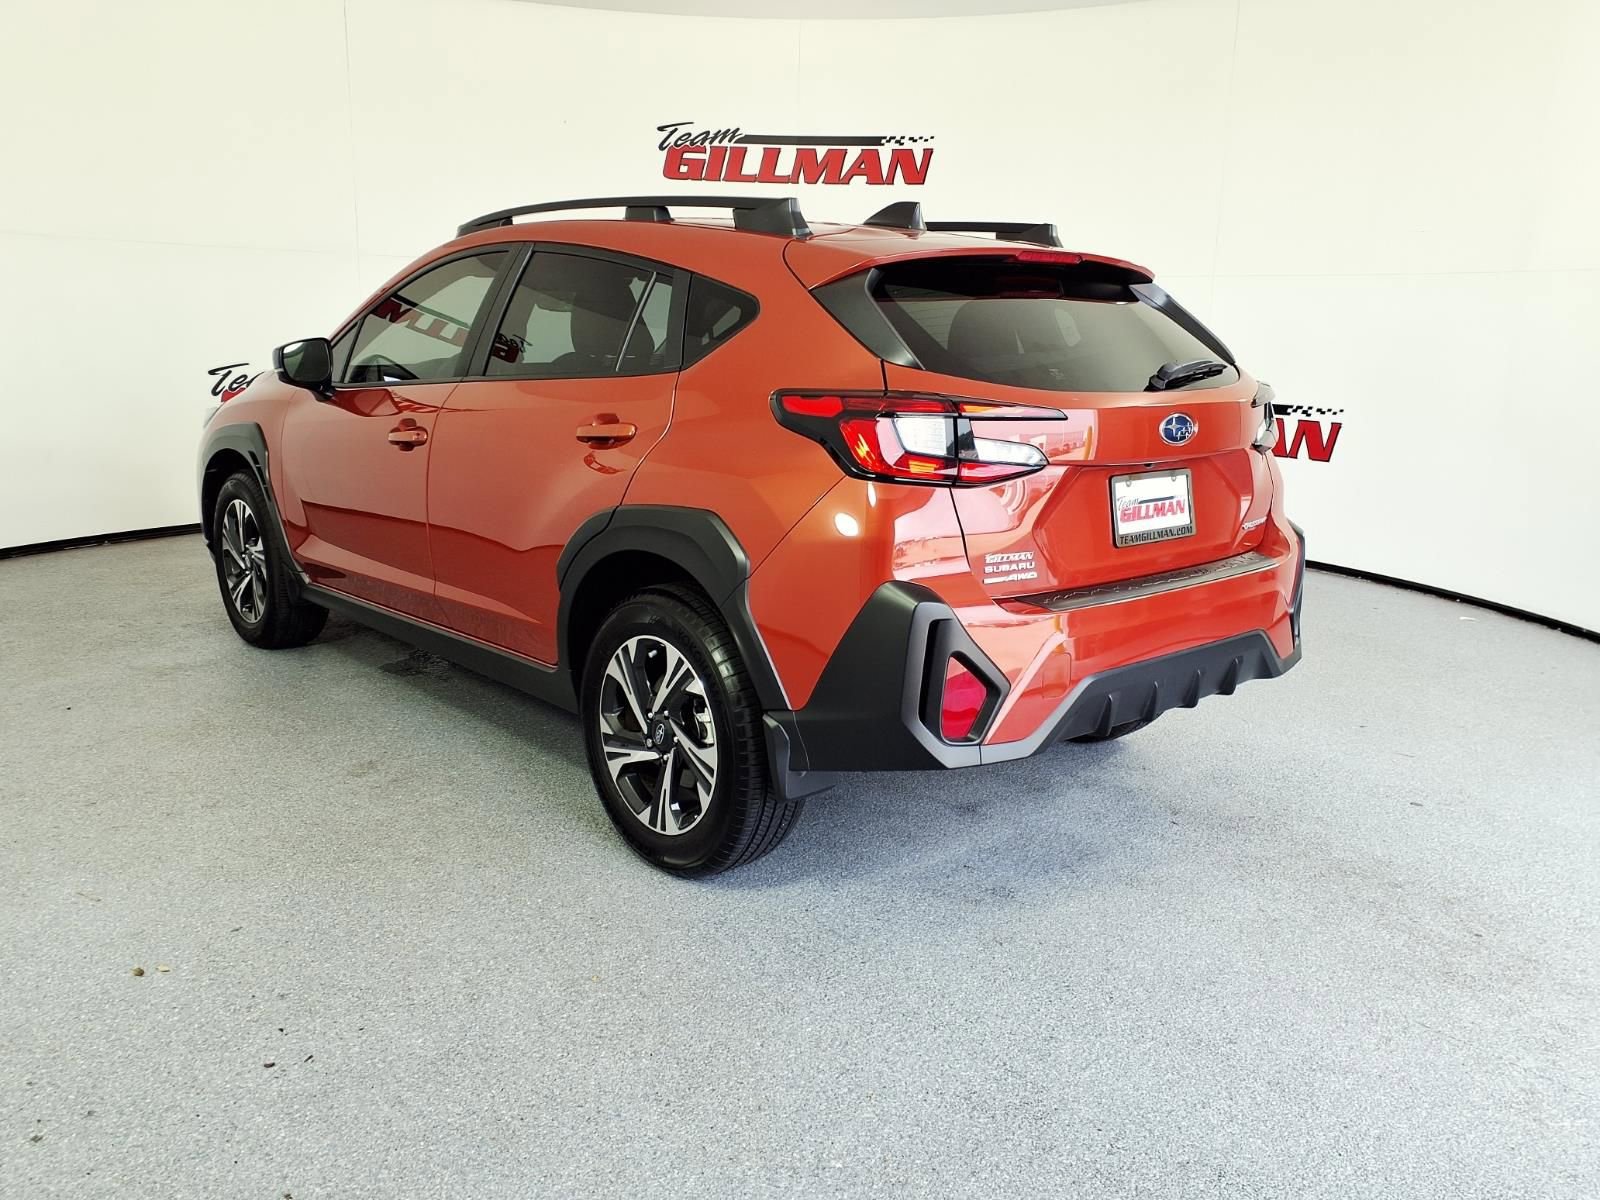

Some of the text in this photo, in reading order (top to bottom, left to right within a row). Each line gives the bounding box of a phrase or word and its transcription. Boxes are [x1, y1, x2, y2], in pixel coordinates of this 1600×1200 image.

[657, 121, 742, 151] Team
[662, 145, 934, 185] GILLMAN
[1119, 500, 1186, 524] GILLMAN
[1119, 526, 1194, 546] TEAMGILLMAN.COM
[984, 561, 1035, 574] SUBARU
